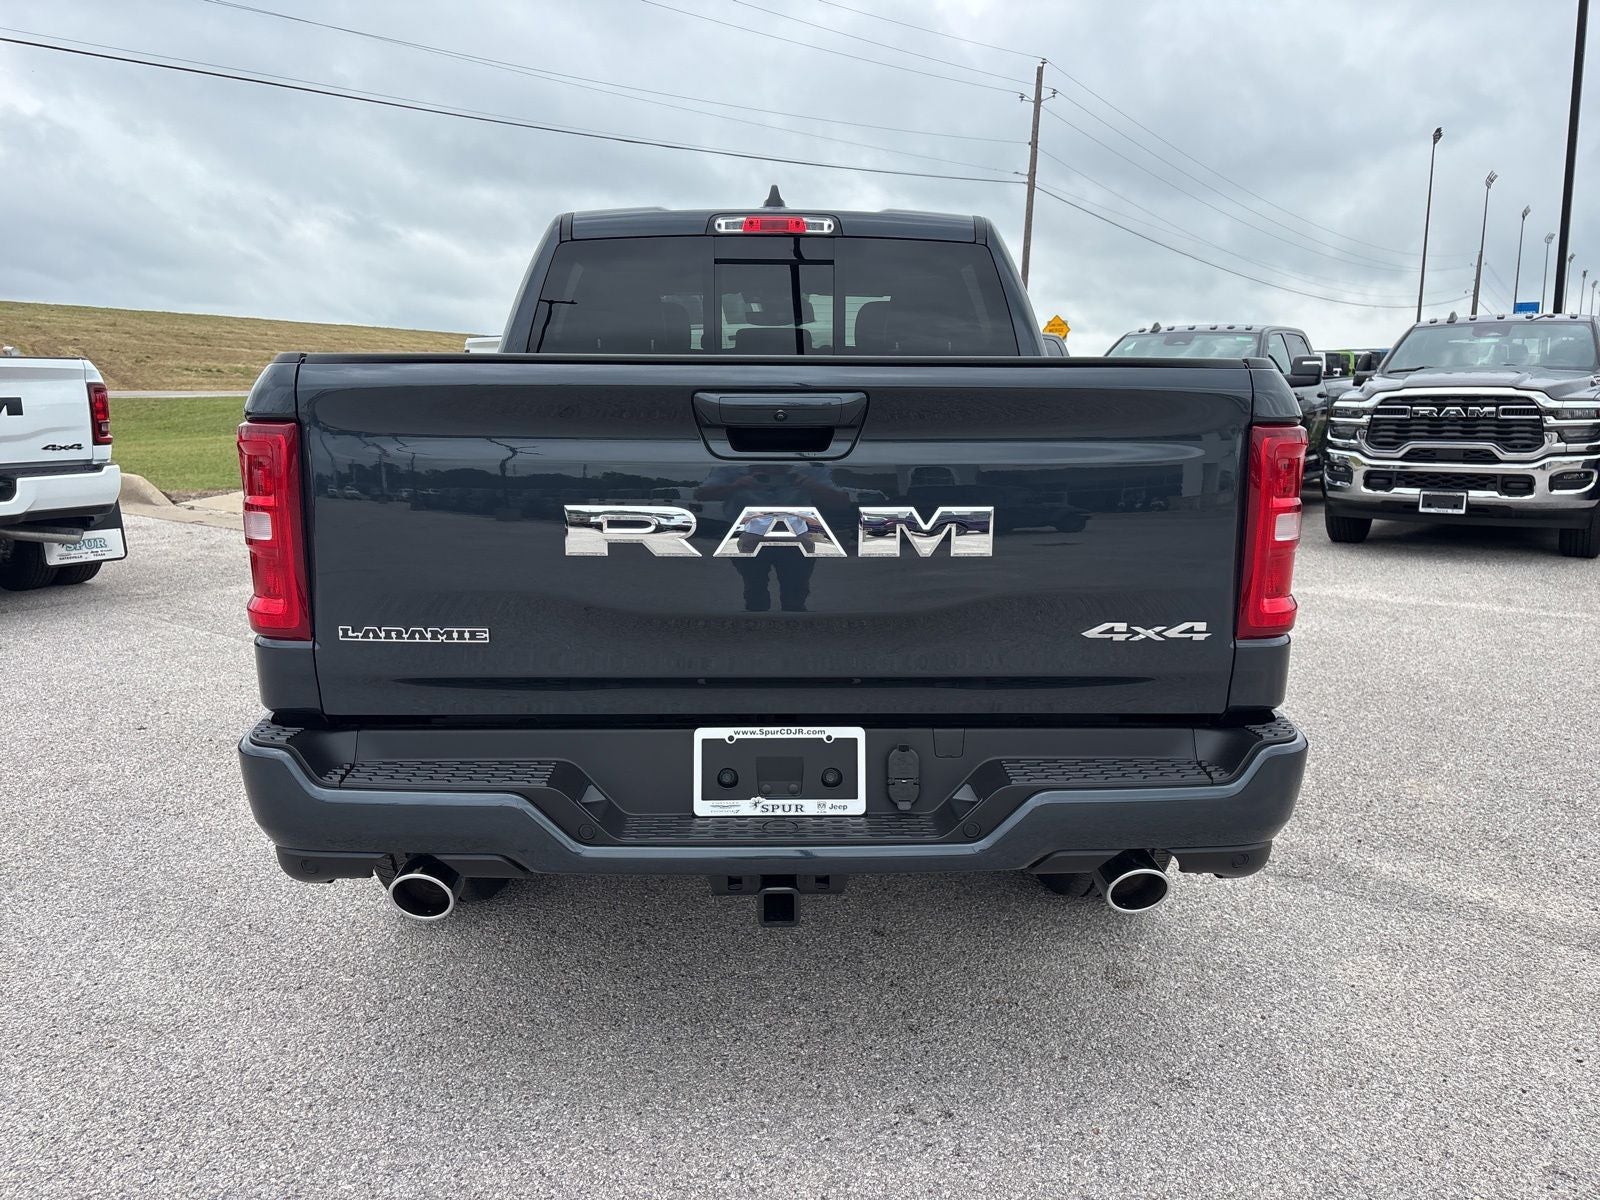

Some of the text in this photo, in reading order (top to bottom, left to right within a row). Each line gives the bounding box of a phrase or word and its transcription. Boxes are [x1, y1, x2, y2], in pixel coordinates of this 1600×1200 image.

[1412, 406, 1496, 417] RAM
[41, 443, 84, 451] 4x4
[563, 503, 995, 558] RAM
[337, 625, 490, 644] LARAMIE
[1082, 621, 1210, 642] 4x4
[733, 728, 826, 737] www.SpurCDJR.com
[760, 803, 806, 813] SPUR
[828, 803, 848, 811] Jeep
